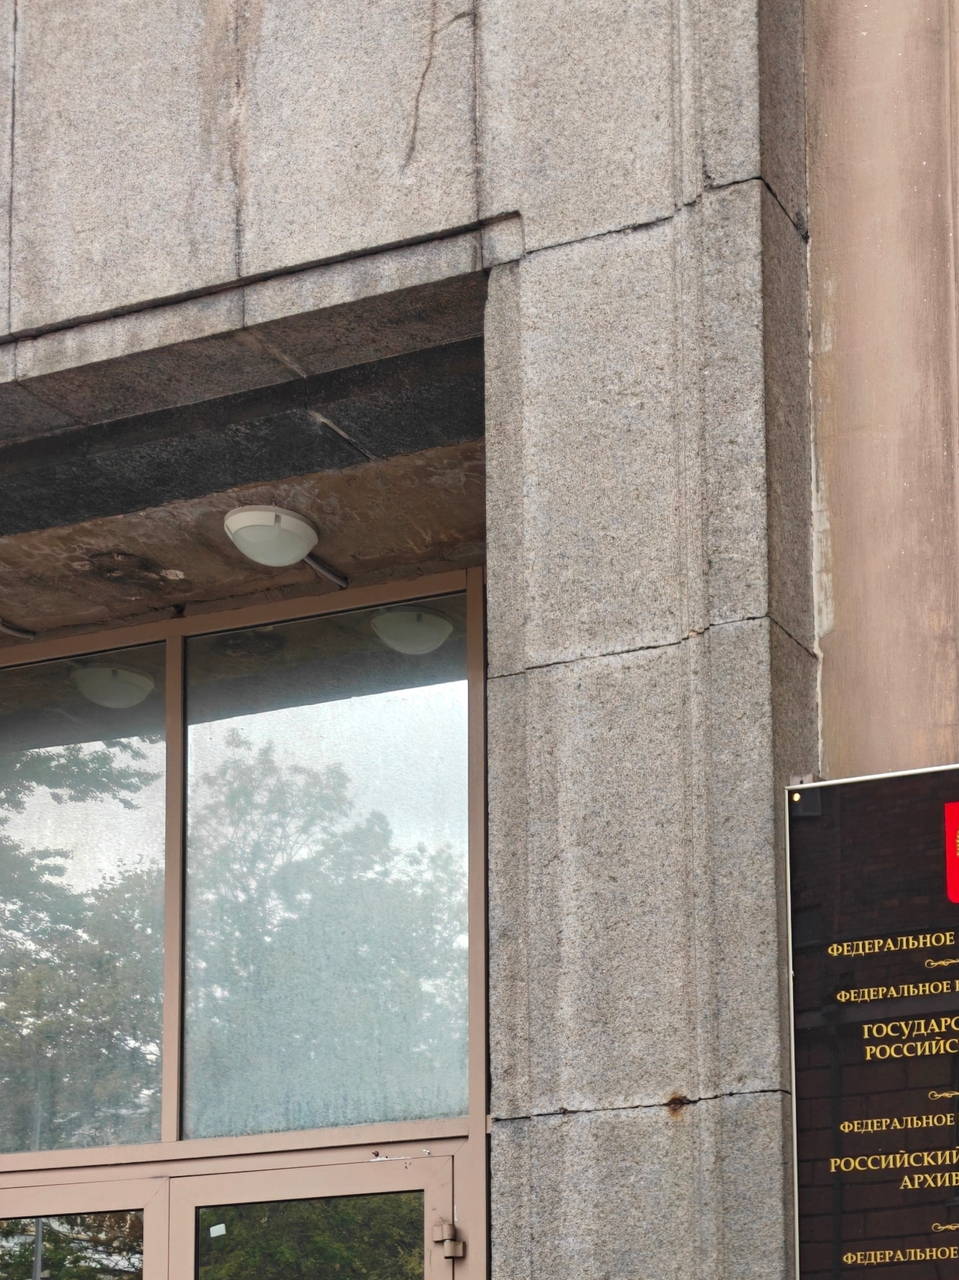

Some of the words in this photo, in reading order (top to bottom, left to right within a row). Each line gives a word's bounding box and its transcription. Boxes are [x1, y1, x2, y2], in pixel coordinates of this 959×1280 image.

[828, 933, 955, 957] ФЕДЕРАЛЬНОЕ
[837, 982, 952, 1003] ФЕДЕРАЛЬНОЕ
[840, 1113, 955, 1134] ФЕДЕРАЛЬНОЕ
[843, 1246, 958, 1265] ФЕДЕРАЛЬНОЕ
